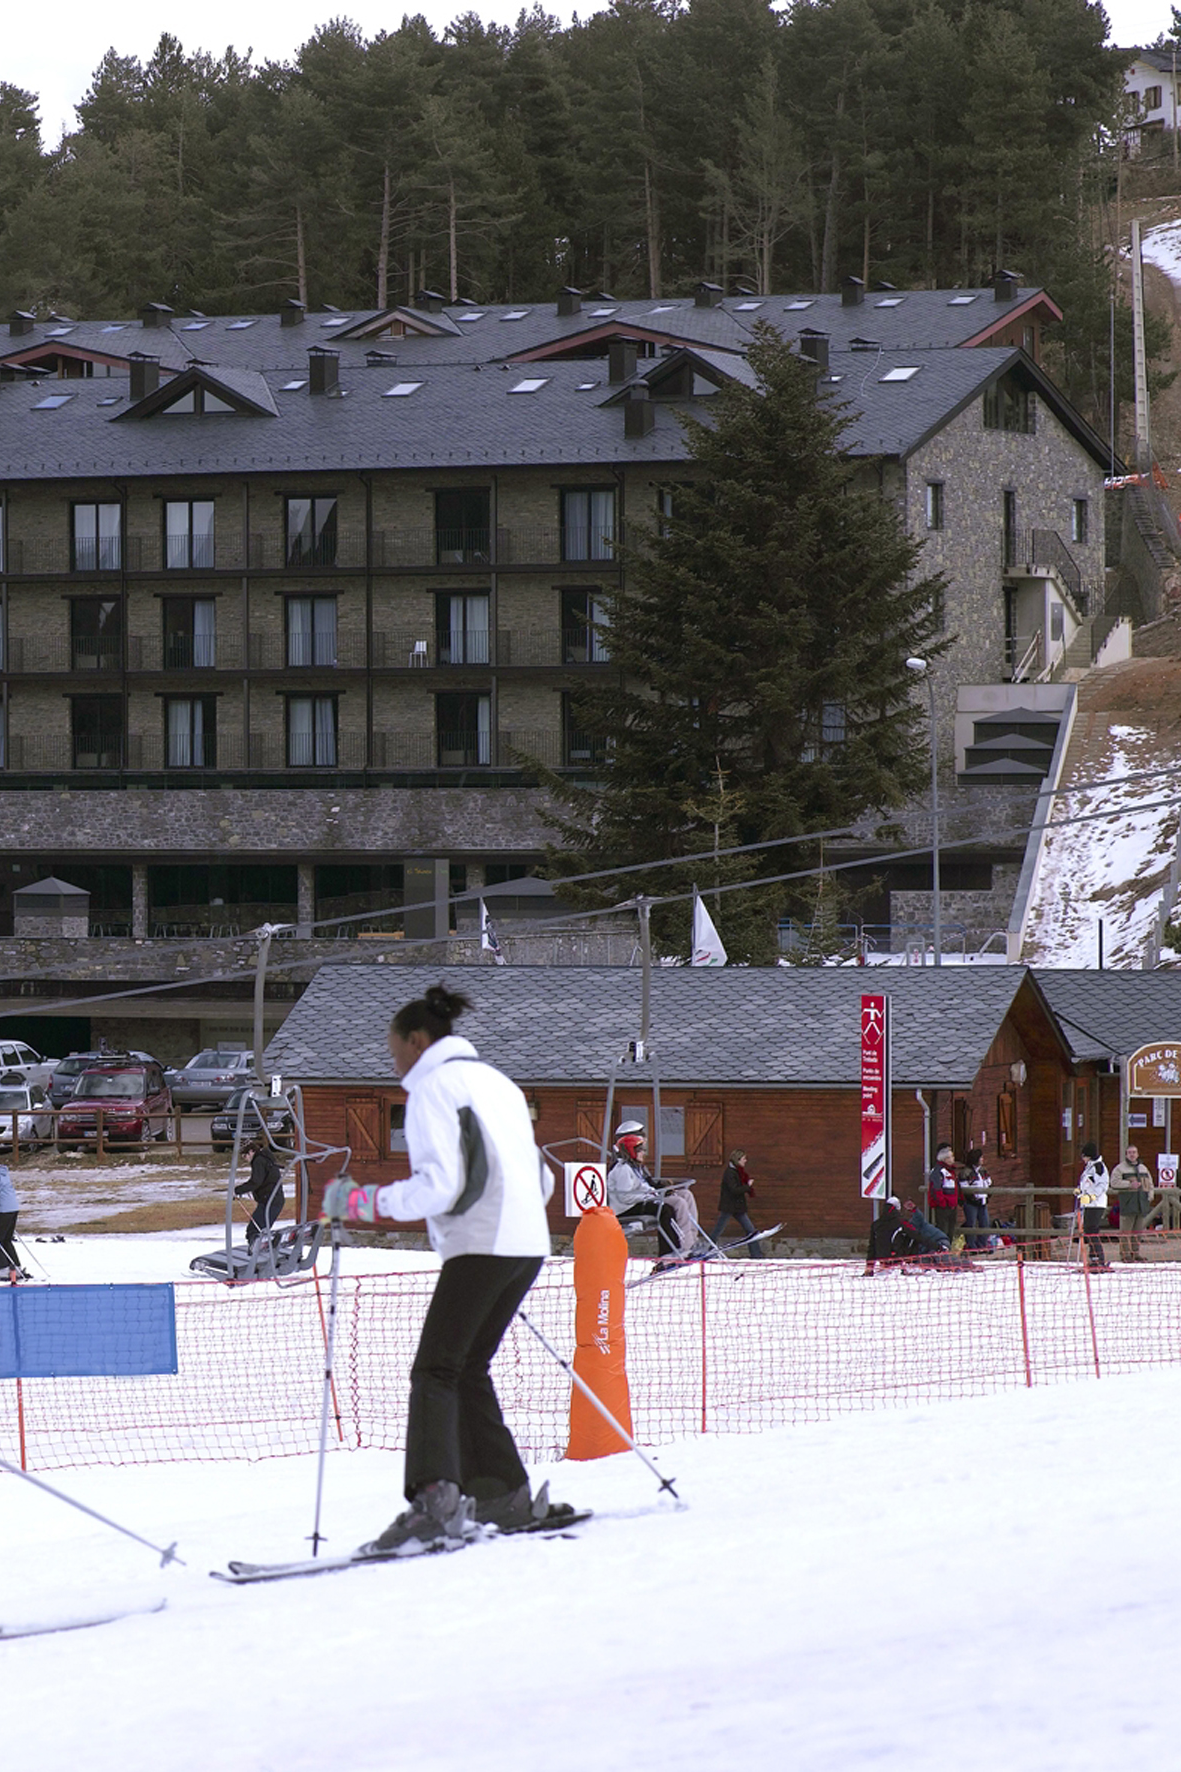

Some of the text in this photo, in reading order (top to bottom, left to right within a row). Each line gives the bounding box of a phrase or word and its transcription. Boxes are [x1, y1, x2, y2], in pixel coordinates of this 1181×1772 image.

[1137, 1049, 1178, 1068] PARC DE
[597, 1289, 610, 1341] La Molina
